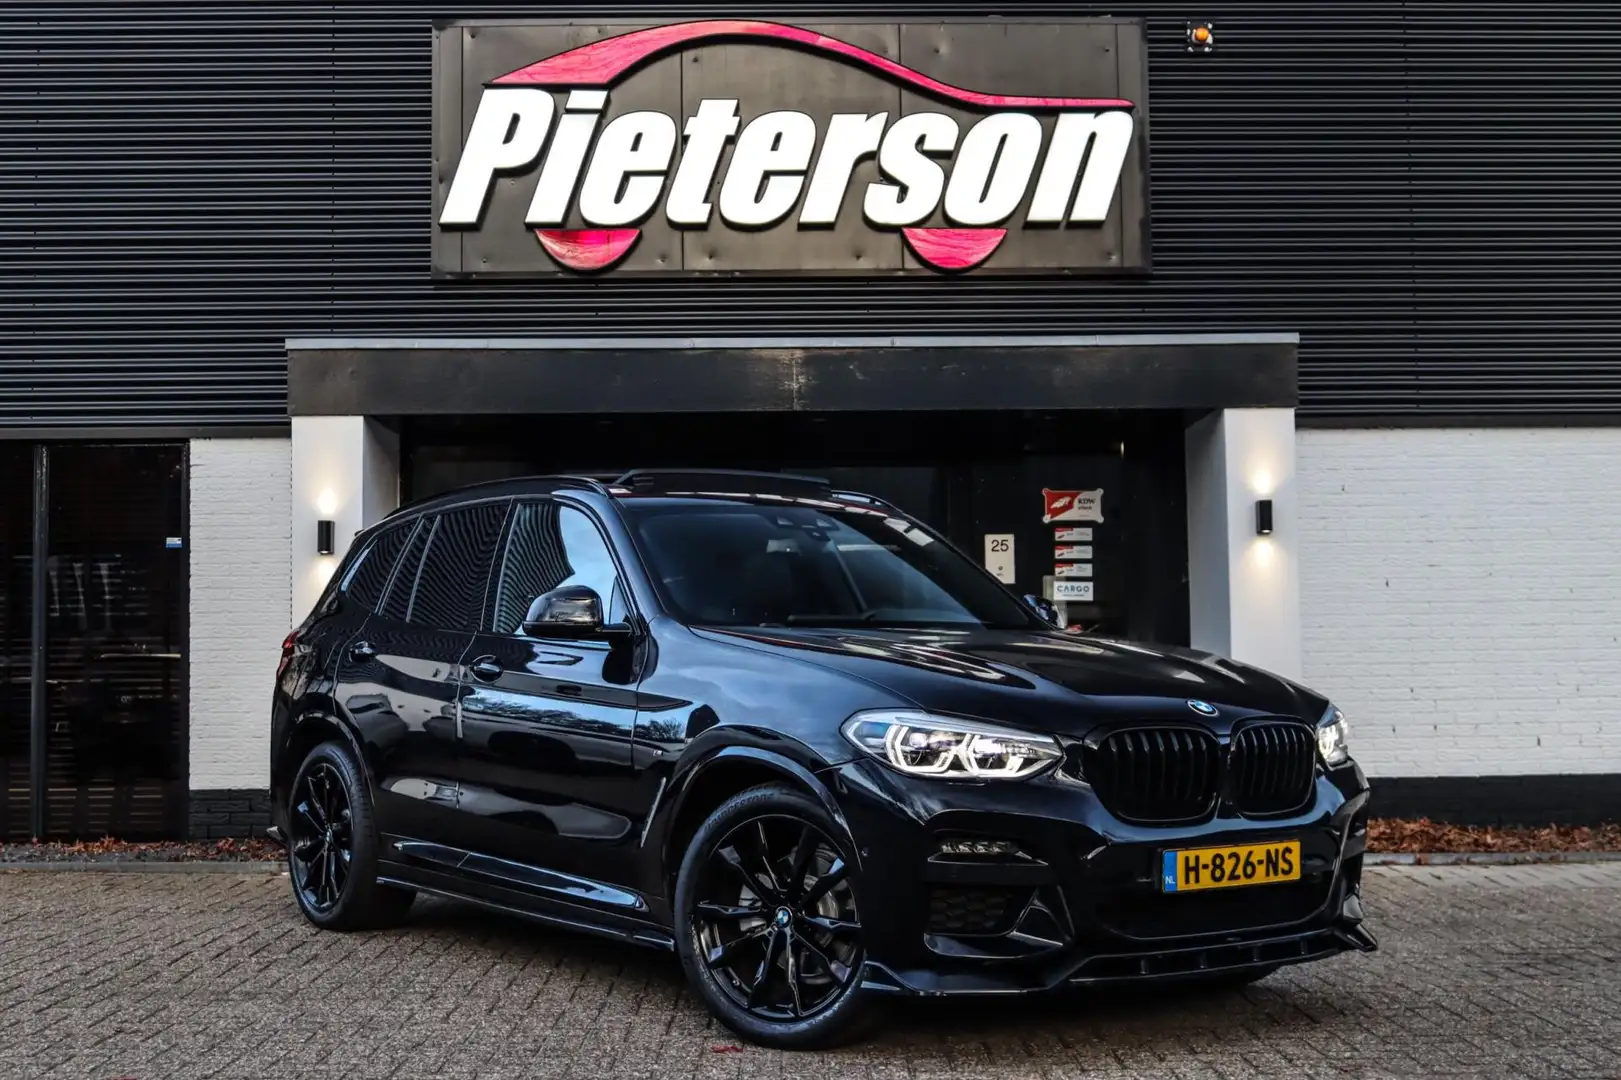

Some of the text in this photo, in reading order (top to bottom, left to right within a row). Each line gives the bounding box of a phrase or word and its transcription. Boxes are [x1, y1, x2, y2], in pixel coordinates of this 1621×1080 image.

[439, 88, 1134, 226] Pieterson
[991, 539, 1009, 552] 25
[1056, 585, 1090, 593] CARGO
[1165, 846, 1294, 884] NL H-826-NS
